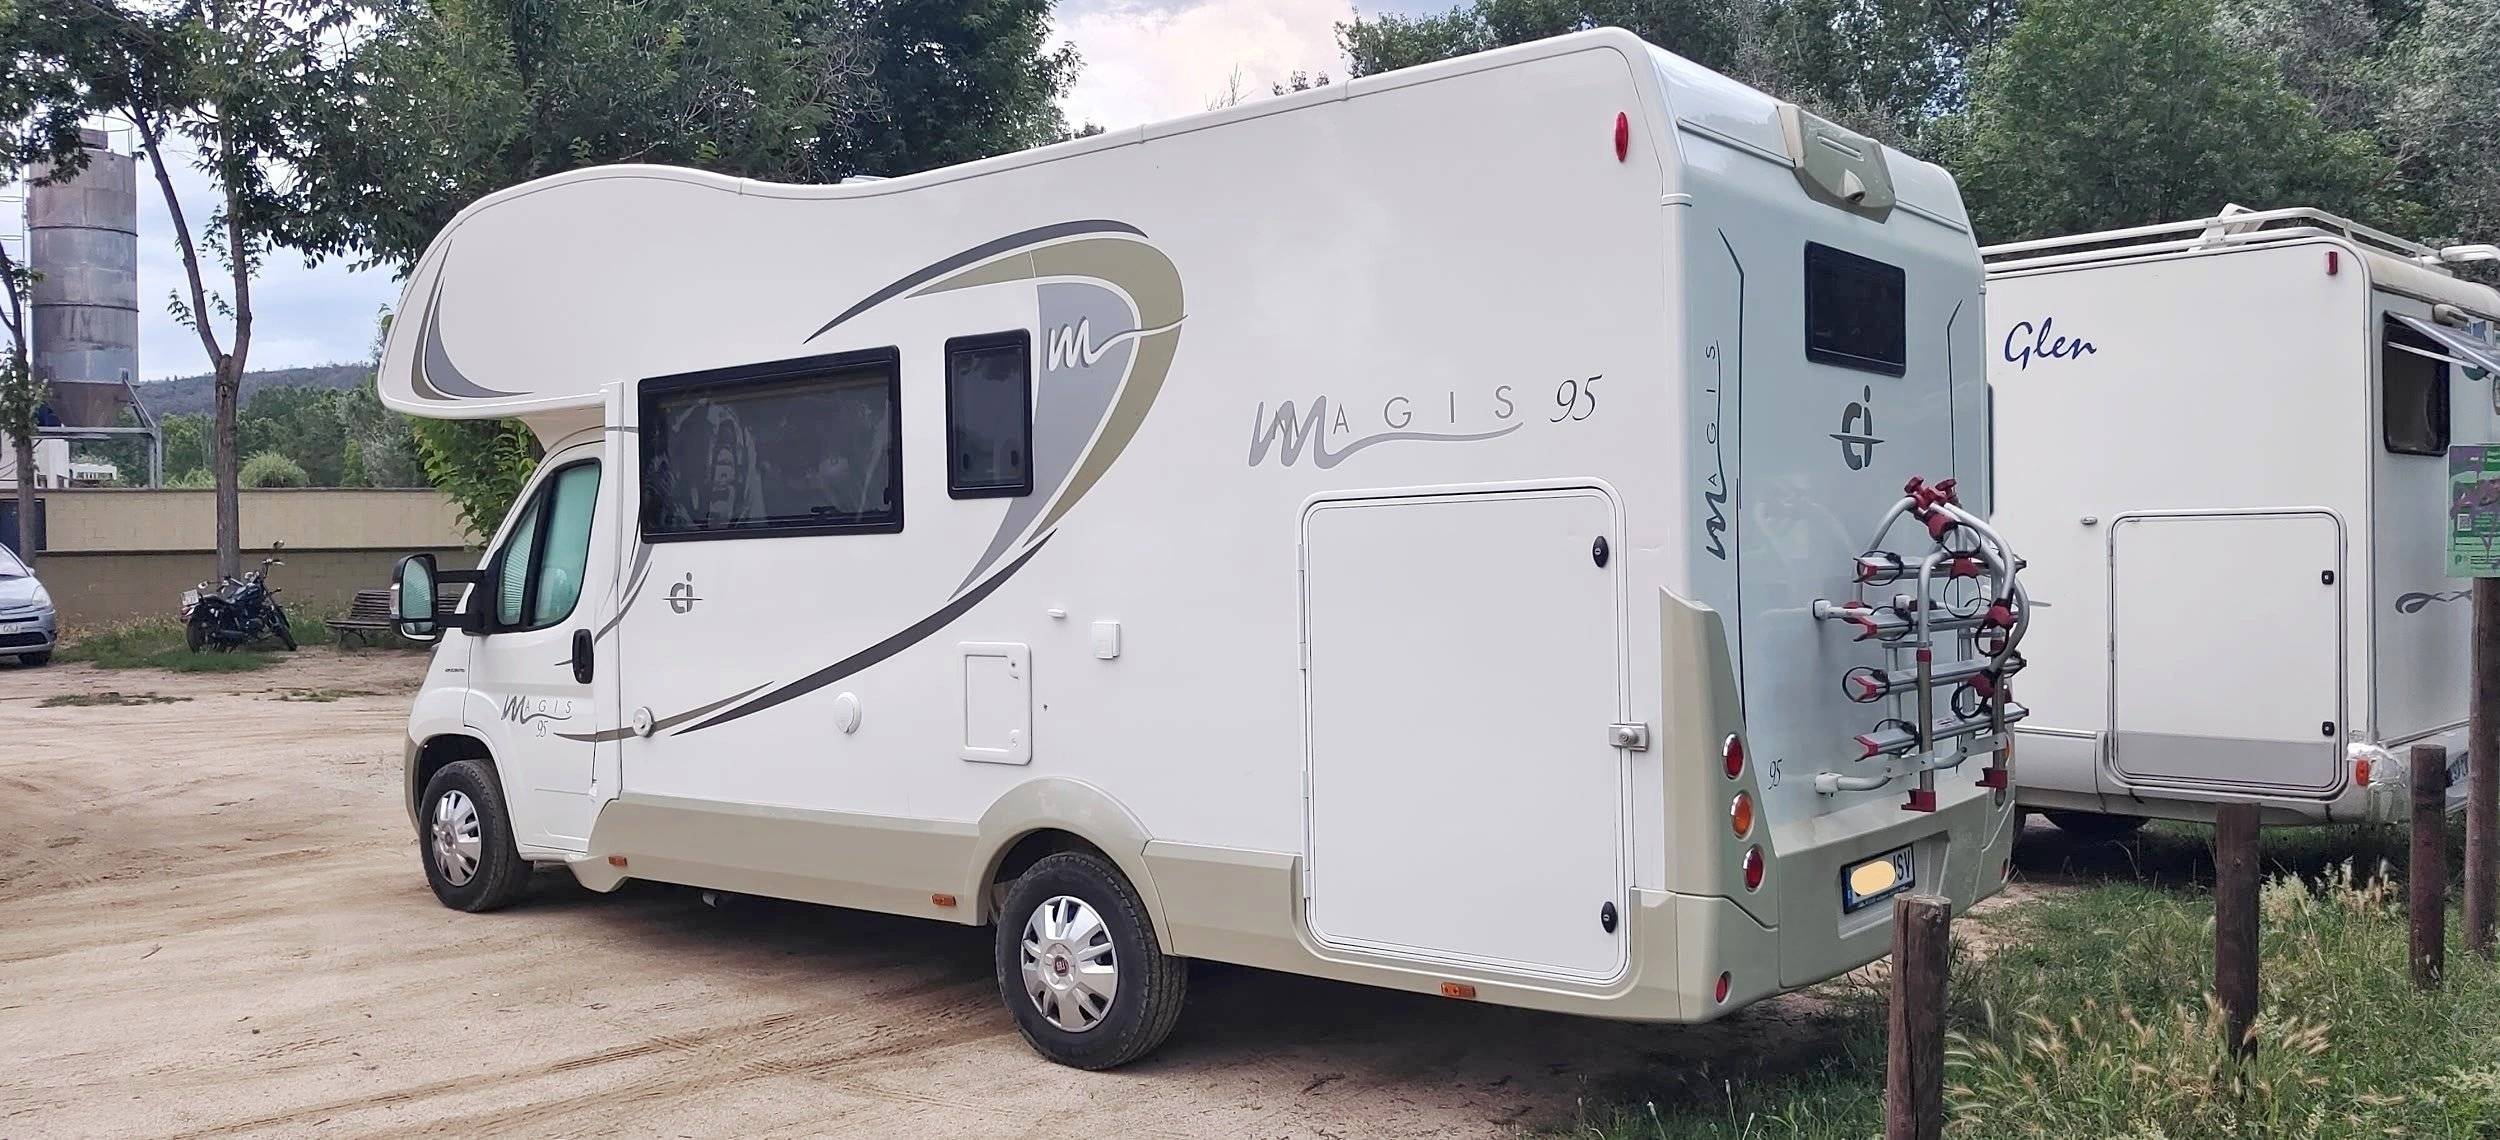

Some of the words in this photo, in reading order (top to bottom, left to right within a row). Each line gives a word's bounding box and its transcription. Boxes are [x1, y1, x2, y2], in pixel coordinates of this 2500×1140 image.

[2004, 316, 2098, 371] Glen
[1248, 385, 1524, 469] MAGIS
[1550, 374, 1603, 423] 95
[1704, 340, 1727, 560] MAGIS
[500, 694, 573, 725] MAGIS
[536, 720, 549, 738] 95
[1768, 758, 1783, 790] 95
